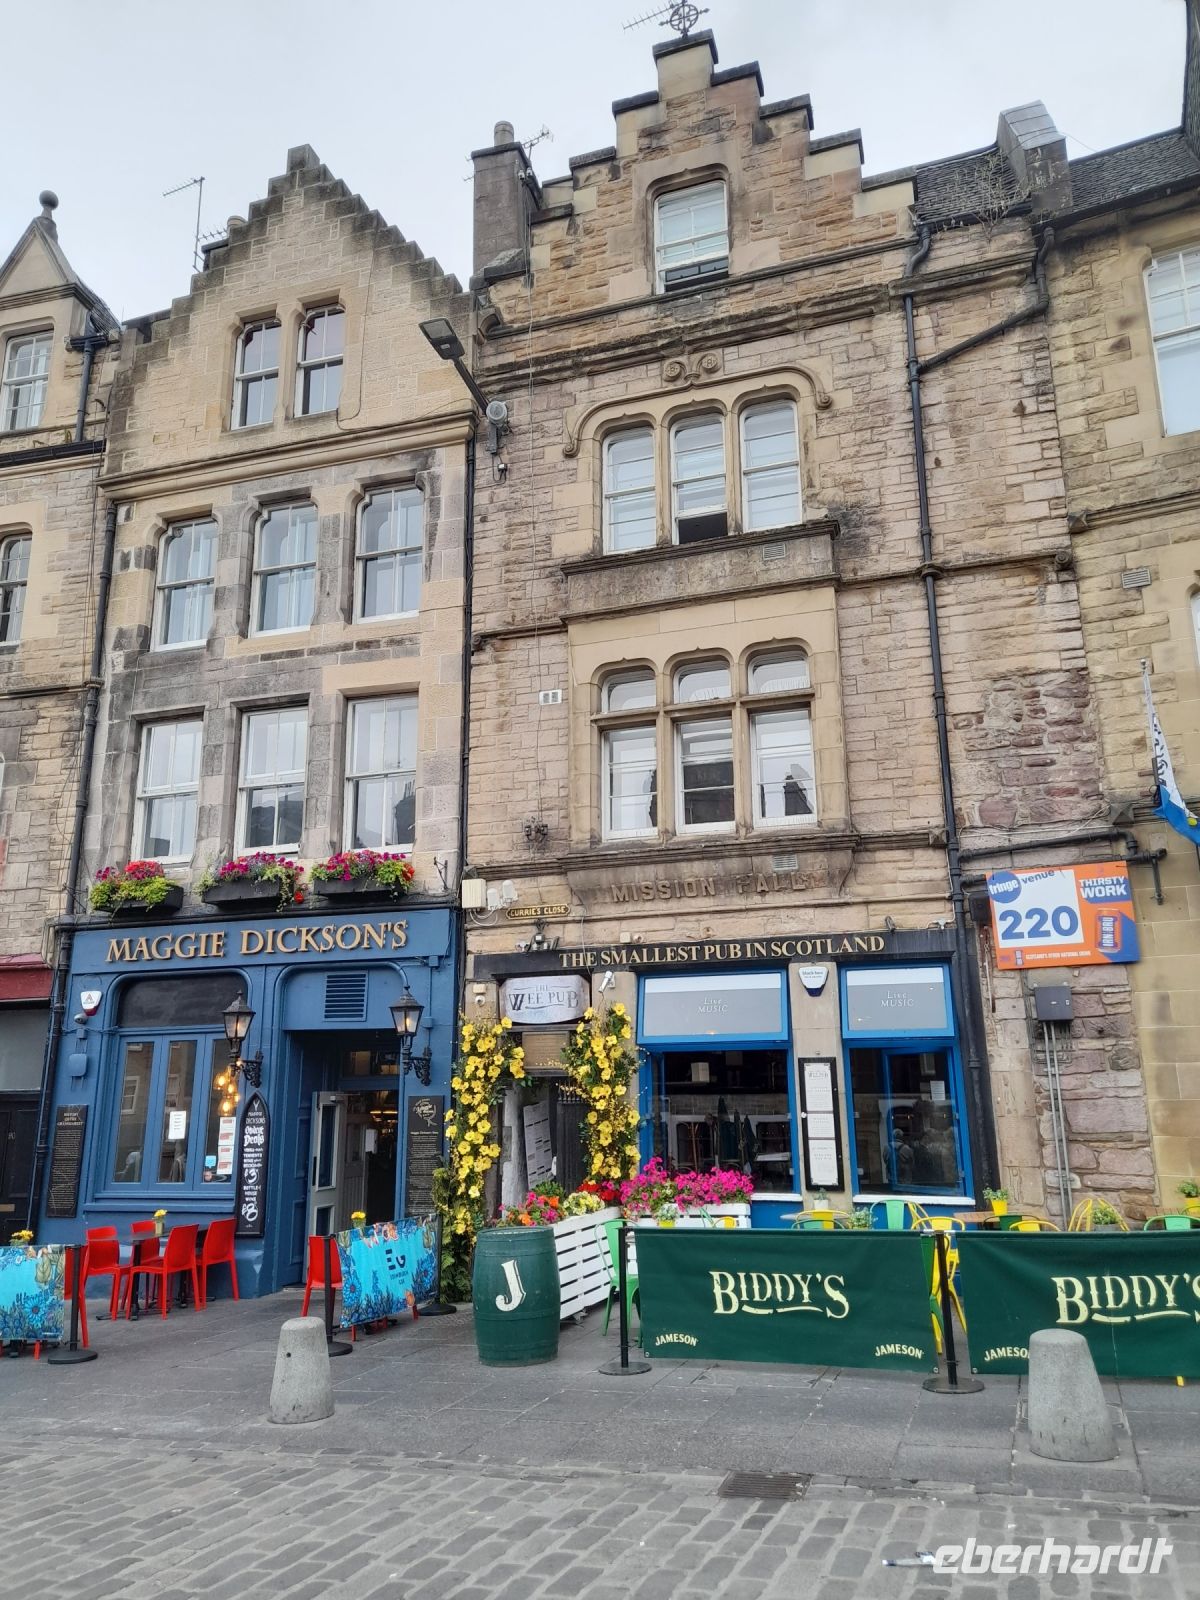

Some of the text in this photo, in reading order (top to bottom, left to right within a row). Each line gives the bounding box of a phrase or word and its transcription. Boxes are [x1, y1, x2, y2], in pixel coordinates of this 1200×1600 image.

[611, 877, 716, 903] MISSION
[989, 869, 1056, 895] fringe venue
[1079, 876, 1125, 887] THIRSTY
[1080, 883, 1127, 898] WORK
[543, 905, 566, 915] CLOSE
[998, 905, 1079, 941] 220
[105, 919, 409, 962] MAGGIE DICKSON'S
[559, 935, 885, 968] THE SMALLEST PUB IN SCOTLAND
[509, 990, 578, 1011] WEE PUB
[698, 1004, 728, 1013] MUSIC
[880, 999, 914, 1007] MUSIC
[495, 1259, 527, 1312] J
[709, 1270, 850, 1319] BIDDY'S
[1050, 1272, 1200, 1324] BIDDY'
[655, 1332, 699, 1347] JAMESON
[874, 1343, 925, 1359] JAMESON
[983, 1346, 1030, 1362] JAMESO
